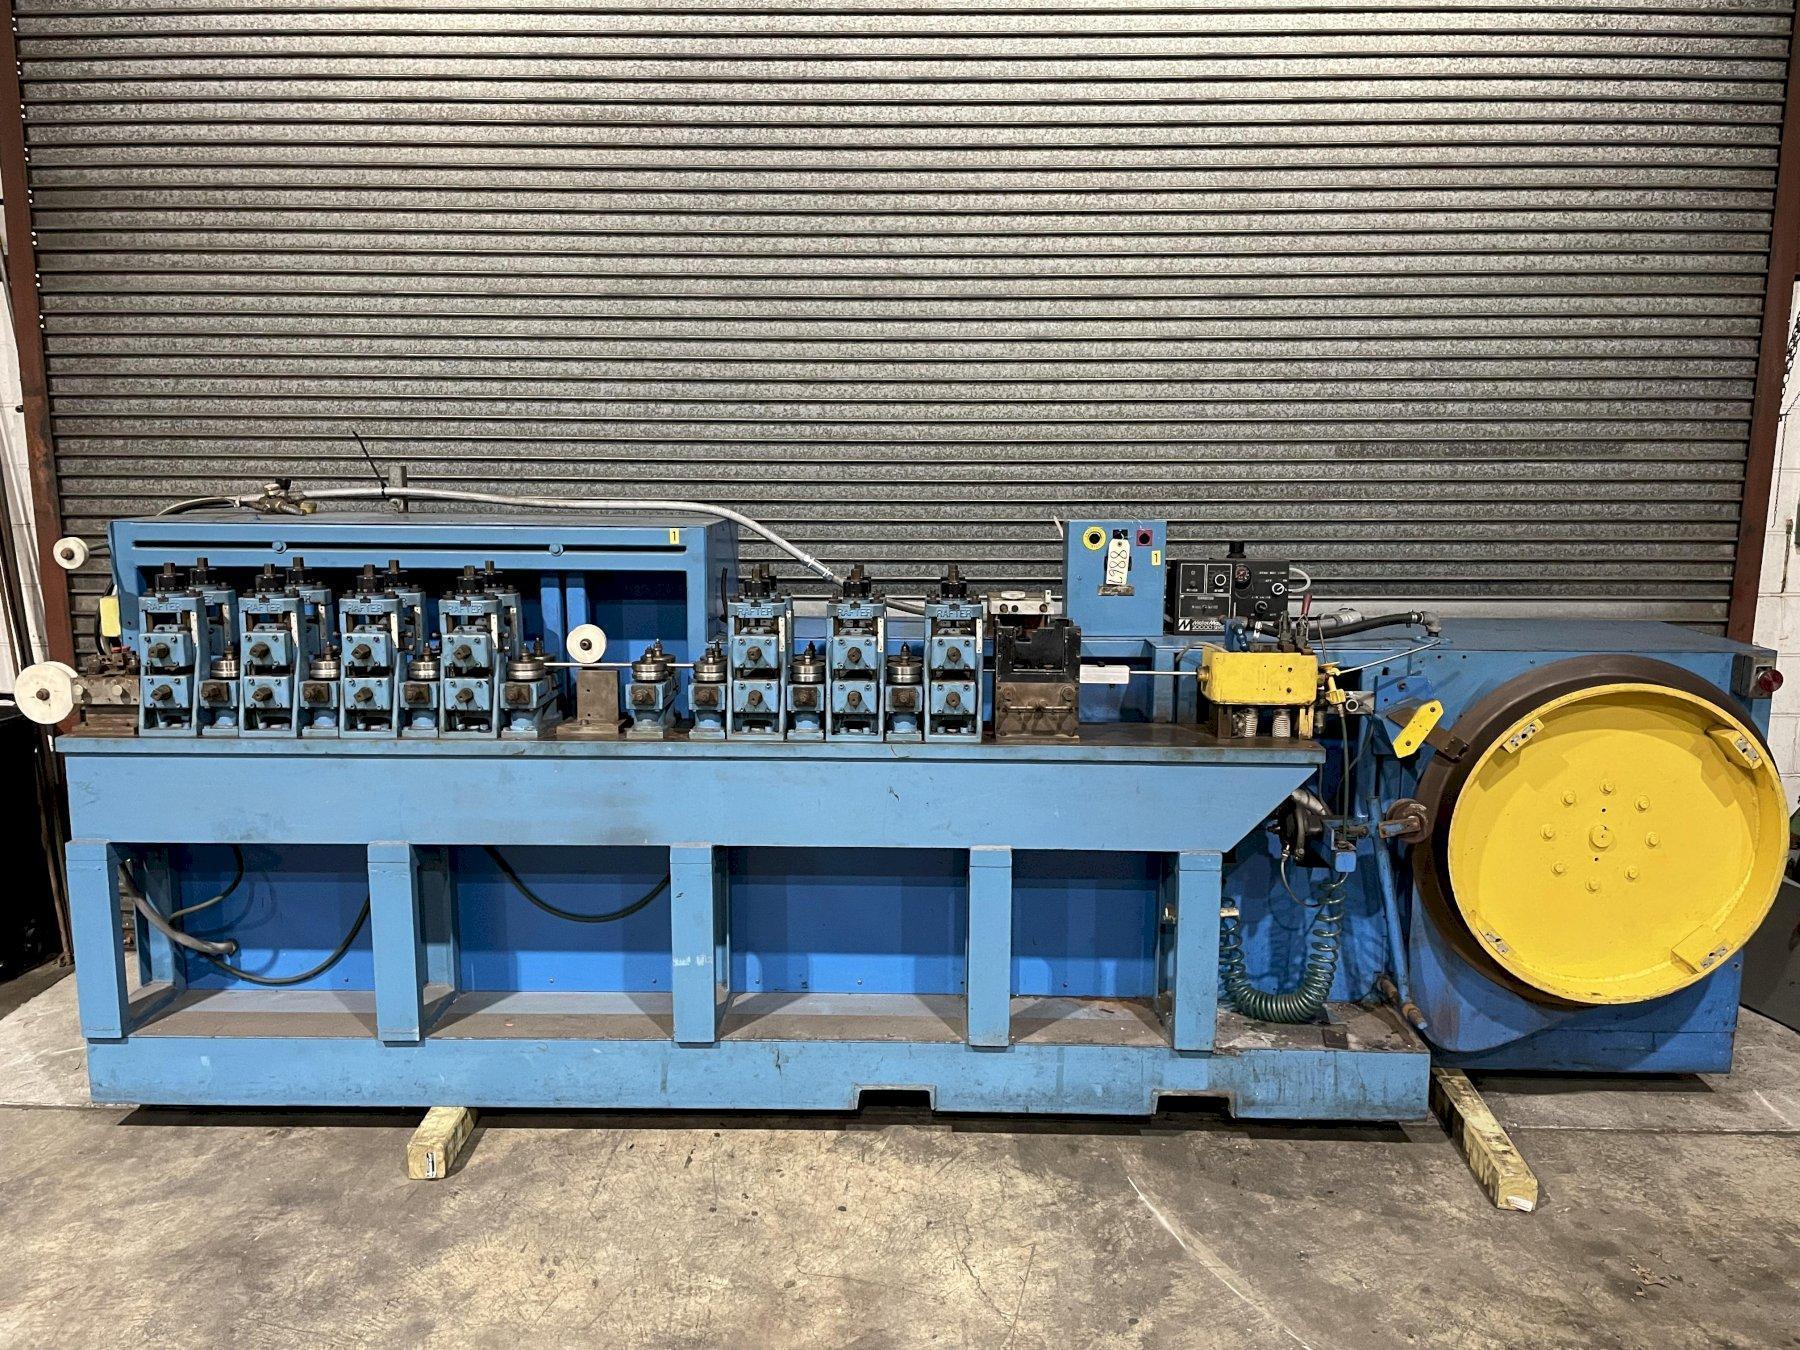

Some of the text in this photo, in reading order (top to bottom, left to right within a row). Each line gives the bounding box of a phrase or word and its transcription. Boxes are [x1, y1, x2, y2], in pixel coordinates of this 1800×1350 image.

[1108, 550, 1127, 584] 8867
[147, 603, 180, 611] RAFTER
[247, 604, 281, 612] RAFTER
[348, 604, 383, 613] RAFTER
[449, 604, 483, 613] RAFTER
[737, 608, 773, 616] RAFTER
[837, 608, 872, 617] RAFTER
[936, 609, 972, 618] RAFTER
